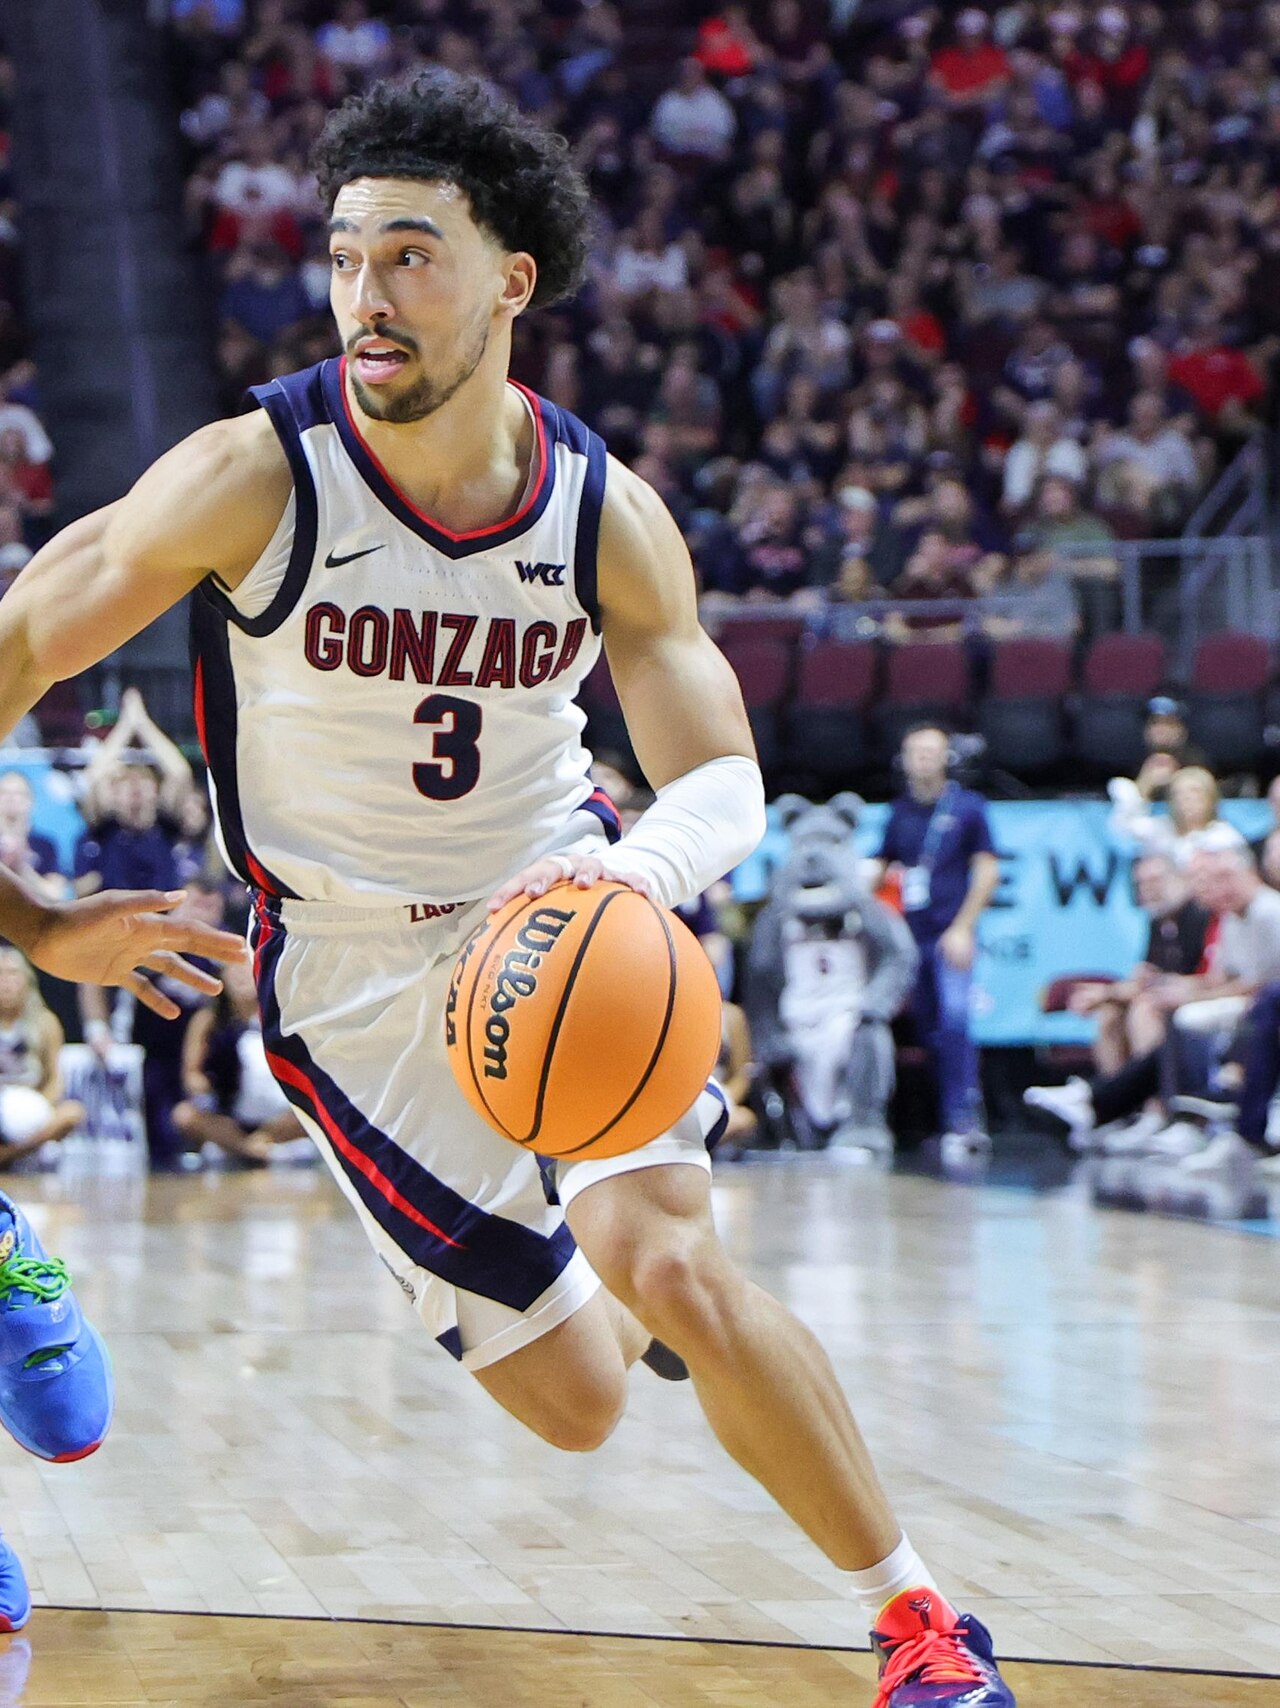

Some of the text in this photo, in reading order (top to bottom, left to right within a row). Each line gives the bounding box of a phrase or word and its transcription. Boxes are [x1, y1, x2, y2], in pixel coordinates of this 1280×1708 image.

[514, 560, 567, 587] WCC
[304, 602, 588, 690] GONZAGA
[412, 693, 483, 801] 3
[483, 907, 577, 1081] Wilson
